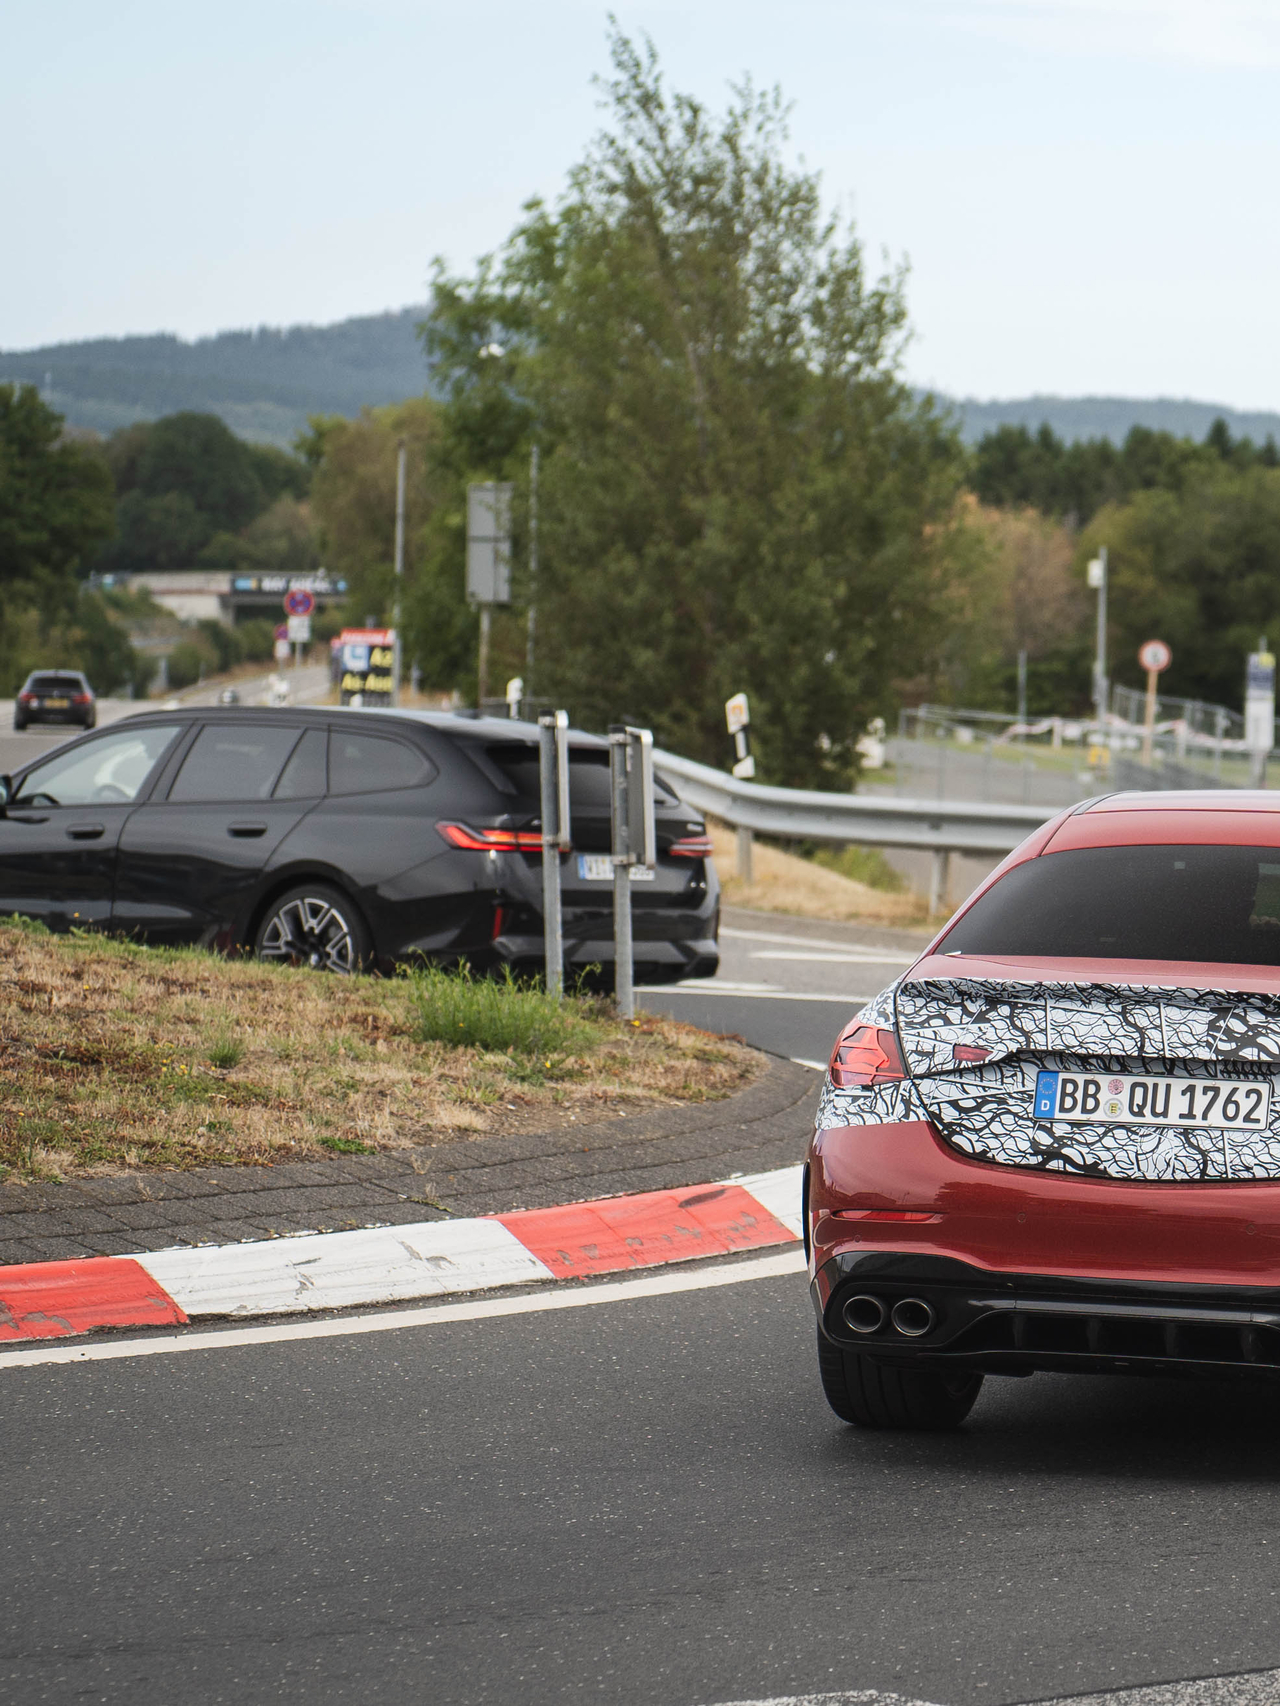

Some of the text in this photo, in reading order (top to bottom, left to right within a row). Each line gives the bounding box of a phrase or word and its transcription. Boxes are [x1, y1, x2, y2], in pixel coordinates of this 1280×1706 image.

[1040, 1100, 1050, 1111] D
[1058, 1078, 1262, 1124] BB QU 1762
